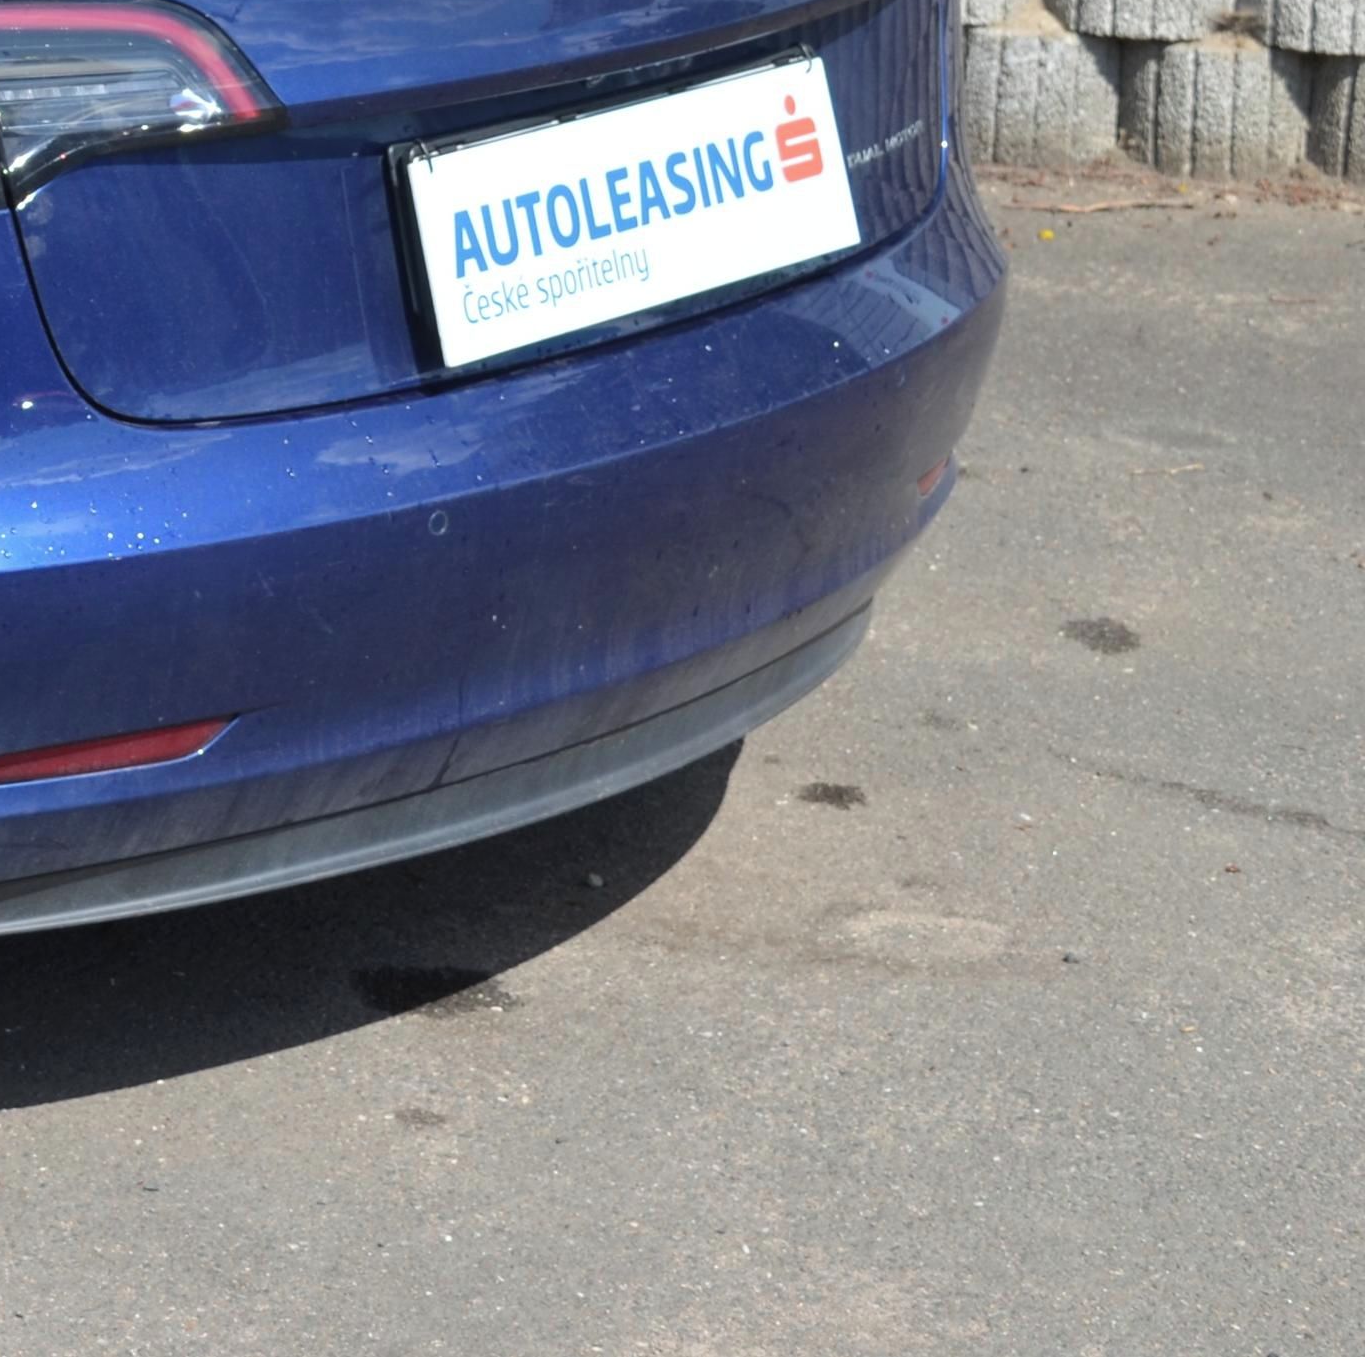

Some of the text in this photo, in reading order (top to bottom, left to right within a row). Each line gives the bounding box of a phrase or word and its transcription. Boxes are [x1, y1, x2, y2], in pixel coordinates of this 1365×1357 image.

[453, 130, 774, 279] AUTOLEASING
[463, 248, 651, 324] České spořitelny
